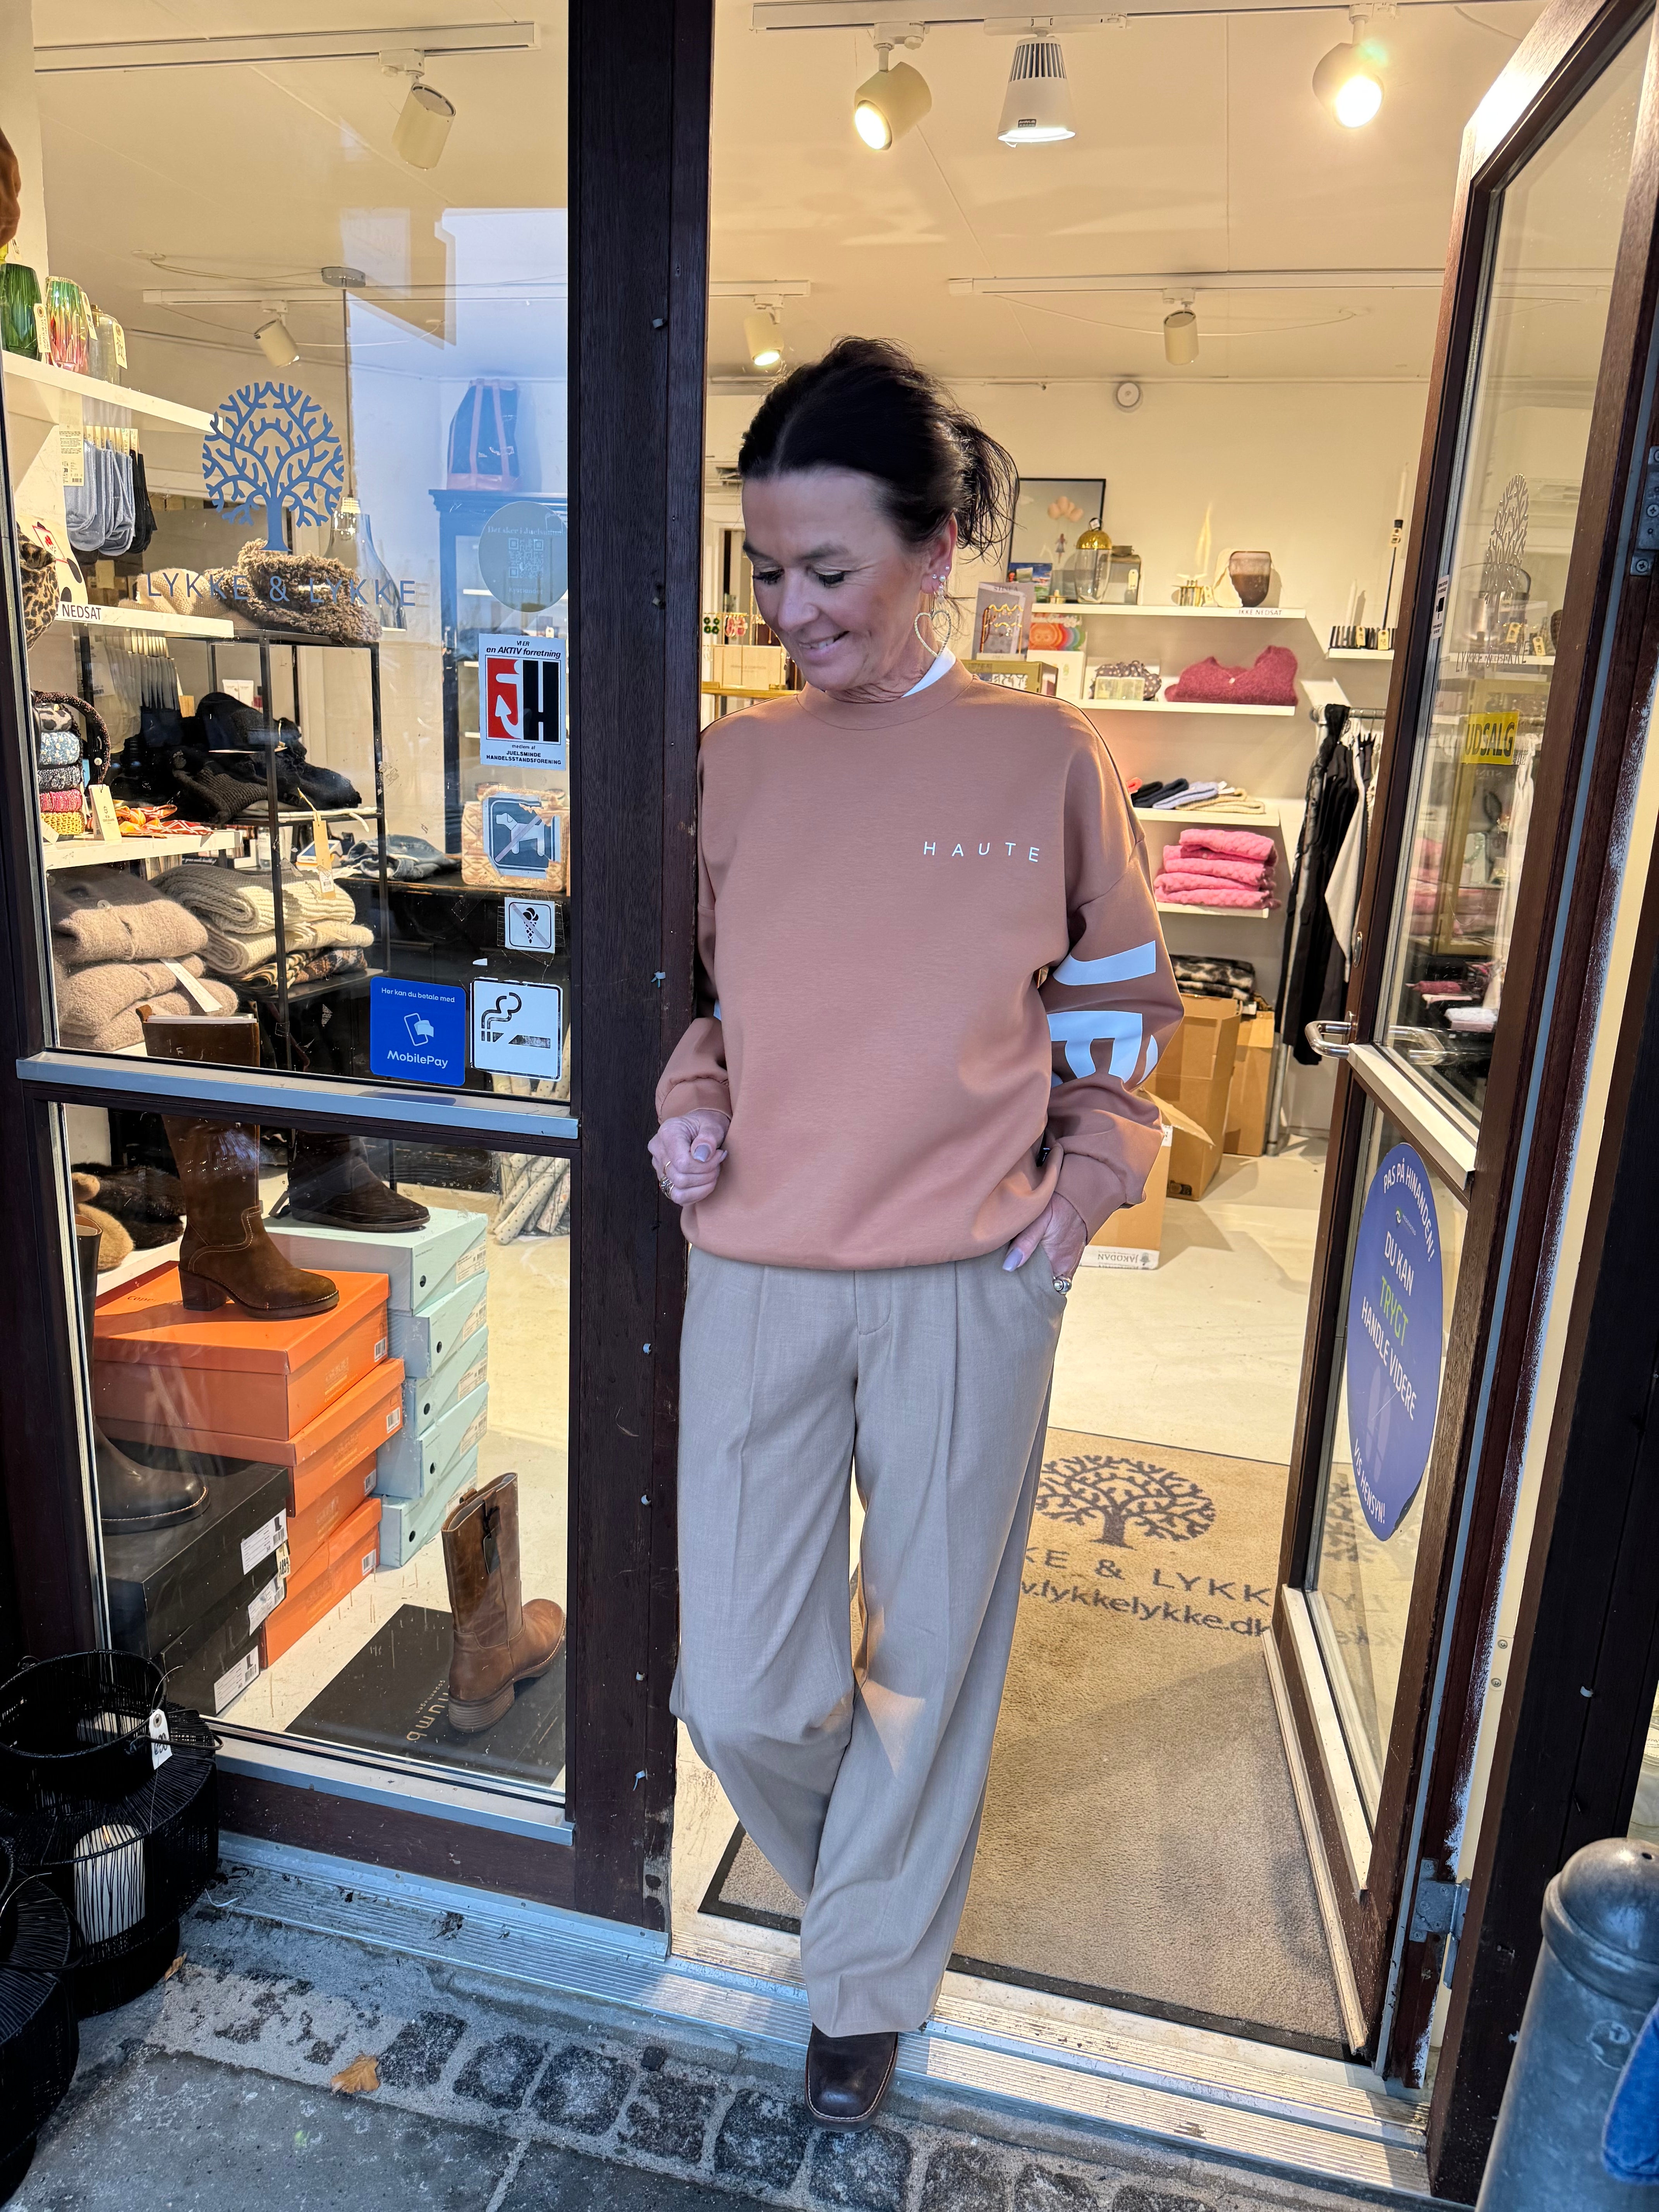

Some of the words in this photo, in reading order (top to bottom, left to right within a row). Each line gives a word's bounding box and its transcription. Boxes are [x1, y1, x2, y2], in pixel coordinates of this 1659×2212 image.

[146, 572, 249, 600] LYKKE
[270, 575, 290, 601] &
[309, 577, 416, 606] LYKKE
[62, 604, 101, 620] NEDSAT
[497, 646, 522, 654] AKTIV
[523, 648, 561, 659] forretning
[1465, 722, 1515, 757] UDSALG
[486, 755, 561, 764] HANDELSSTANDSFORENING
[923, 841, 1040, 863] HAUTE
[417, 992, 439, 1000] betale
[387, 1050, 448, 1069] MobilePay
[1383, 1165, 1396, 1194] PAS
[1396, 1157, 1405, 1183] PÅ
[1405, 1165, 1434, 1262] HINANDEN!
[1384, 1231, 1397, 1266] DU
[1396, 1249, 1415, 1297] KAN
[1380, 1275, 1408, 1346] TRYGT
[1361, 1296, 1390, 1367] HANDLE
[1389, 1347, 1417, 1421] VIDERE
[1354, 1437, 1362, 1476] VIS
[1360, 1470, 1385, 1524] HENSYN!
[1094, 1559, 1126, 1580] &
[415, 1680, 445, 1714] copenhagen
